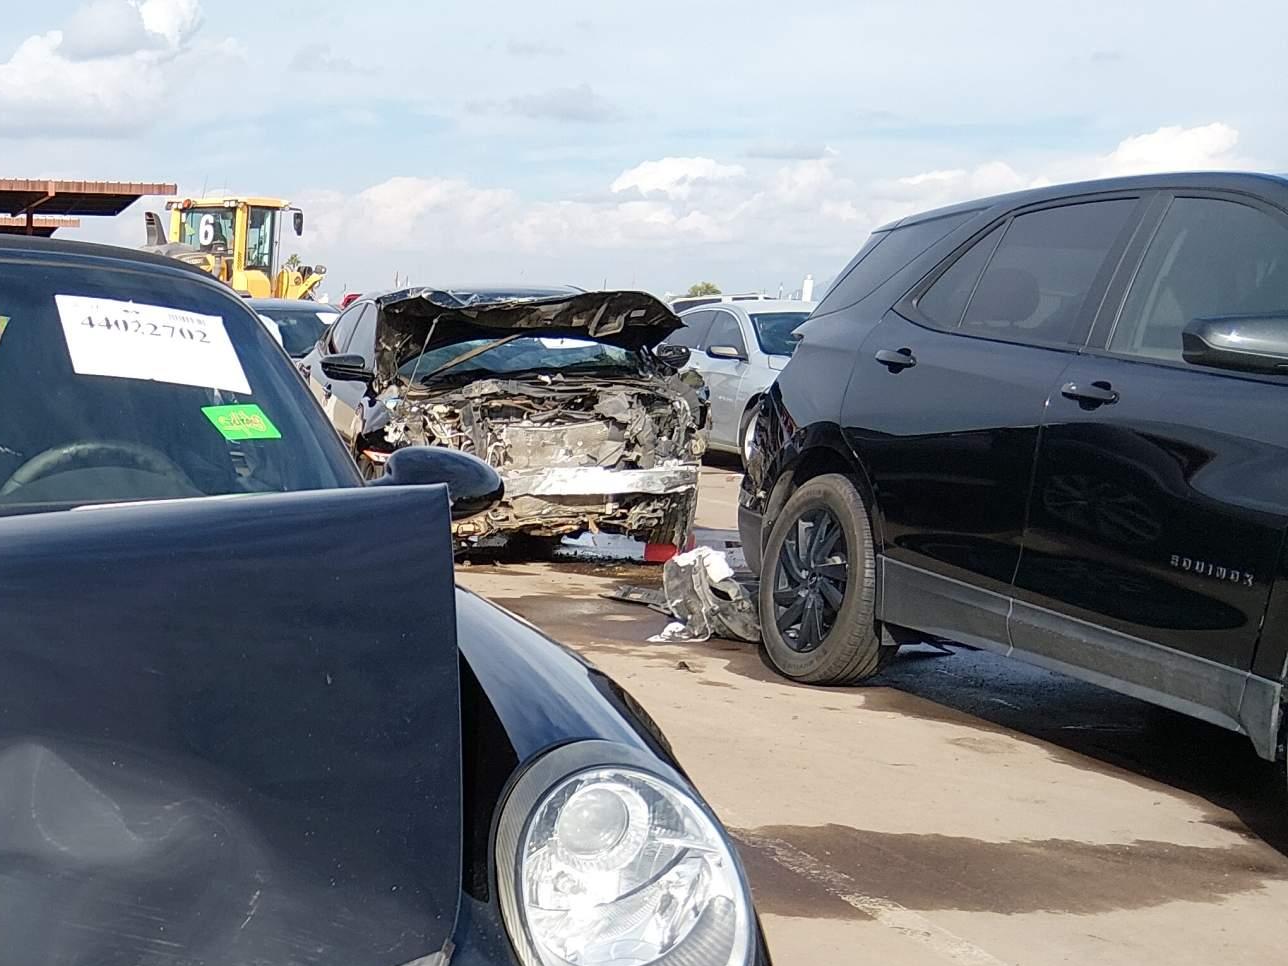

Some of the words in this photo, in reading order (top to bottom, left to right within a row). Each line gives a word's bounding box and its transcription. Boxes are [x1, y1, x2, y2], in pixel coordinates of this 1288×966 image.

[199, 214, 215, 246] 6
[80, 315, 212, 344] 44022702
[1170, 554, 1254, 587] EQUINOX
